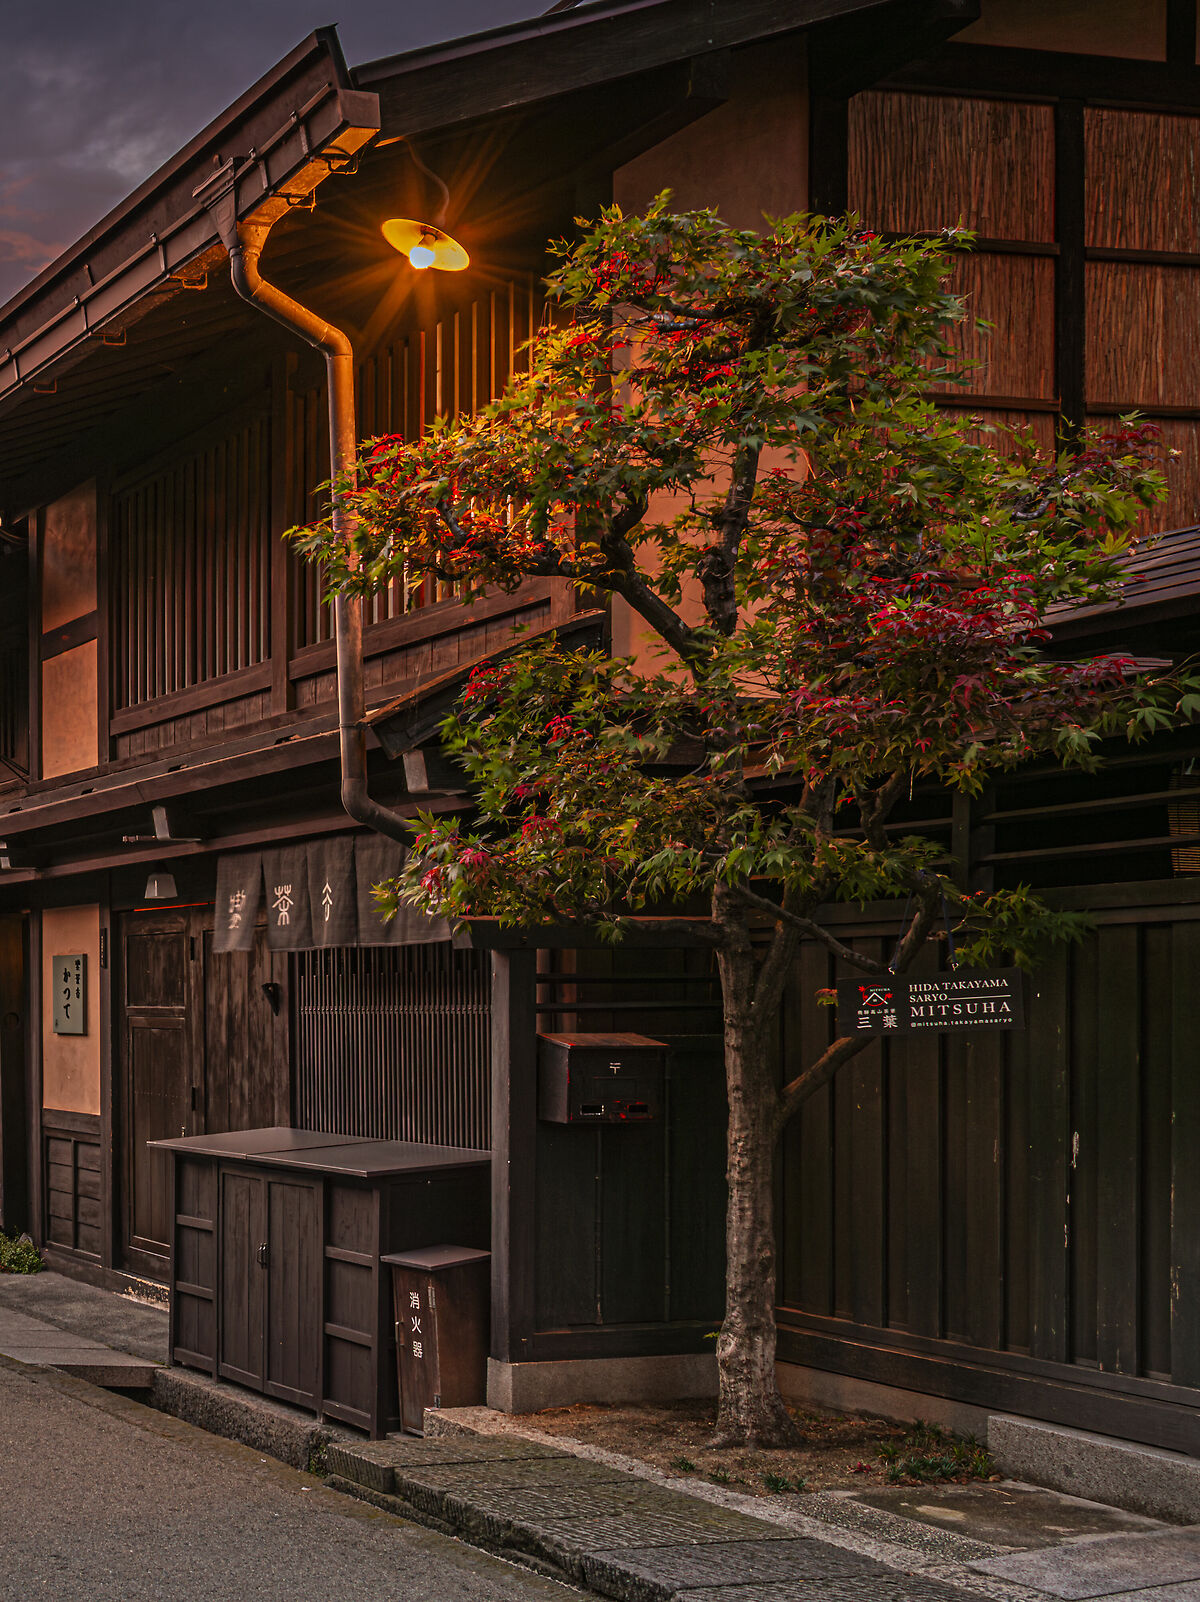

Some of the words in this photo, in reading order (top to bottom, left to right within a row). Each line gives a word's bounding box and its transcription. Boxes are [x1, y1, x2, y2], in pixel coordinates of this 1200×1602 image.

[63, 967, 71, 1019] かつて
[909, 983, 940, 993] HIDA
[941, 979, 1009, 991] TAKAYAMA
[909, 993, 948, 1003] SARYO
[910, 1001, 1012, 1018] MITSUHA
[409, 1291, 424, 1359] 消火器
